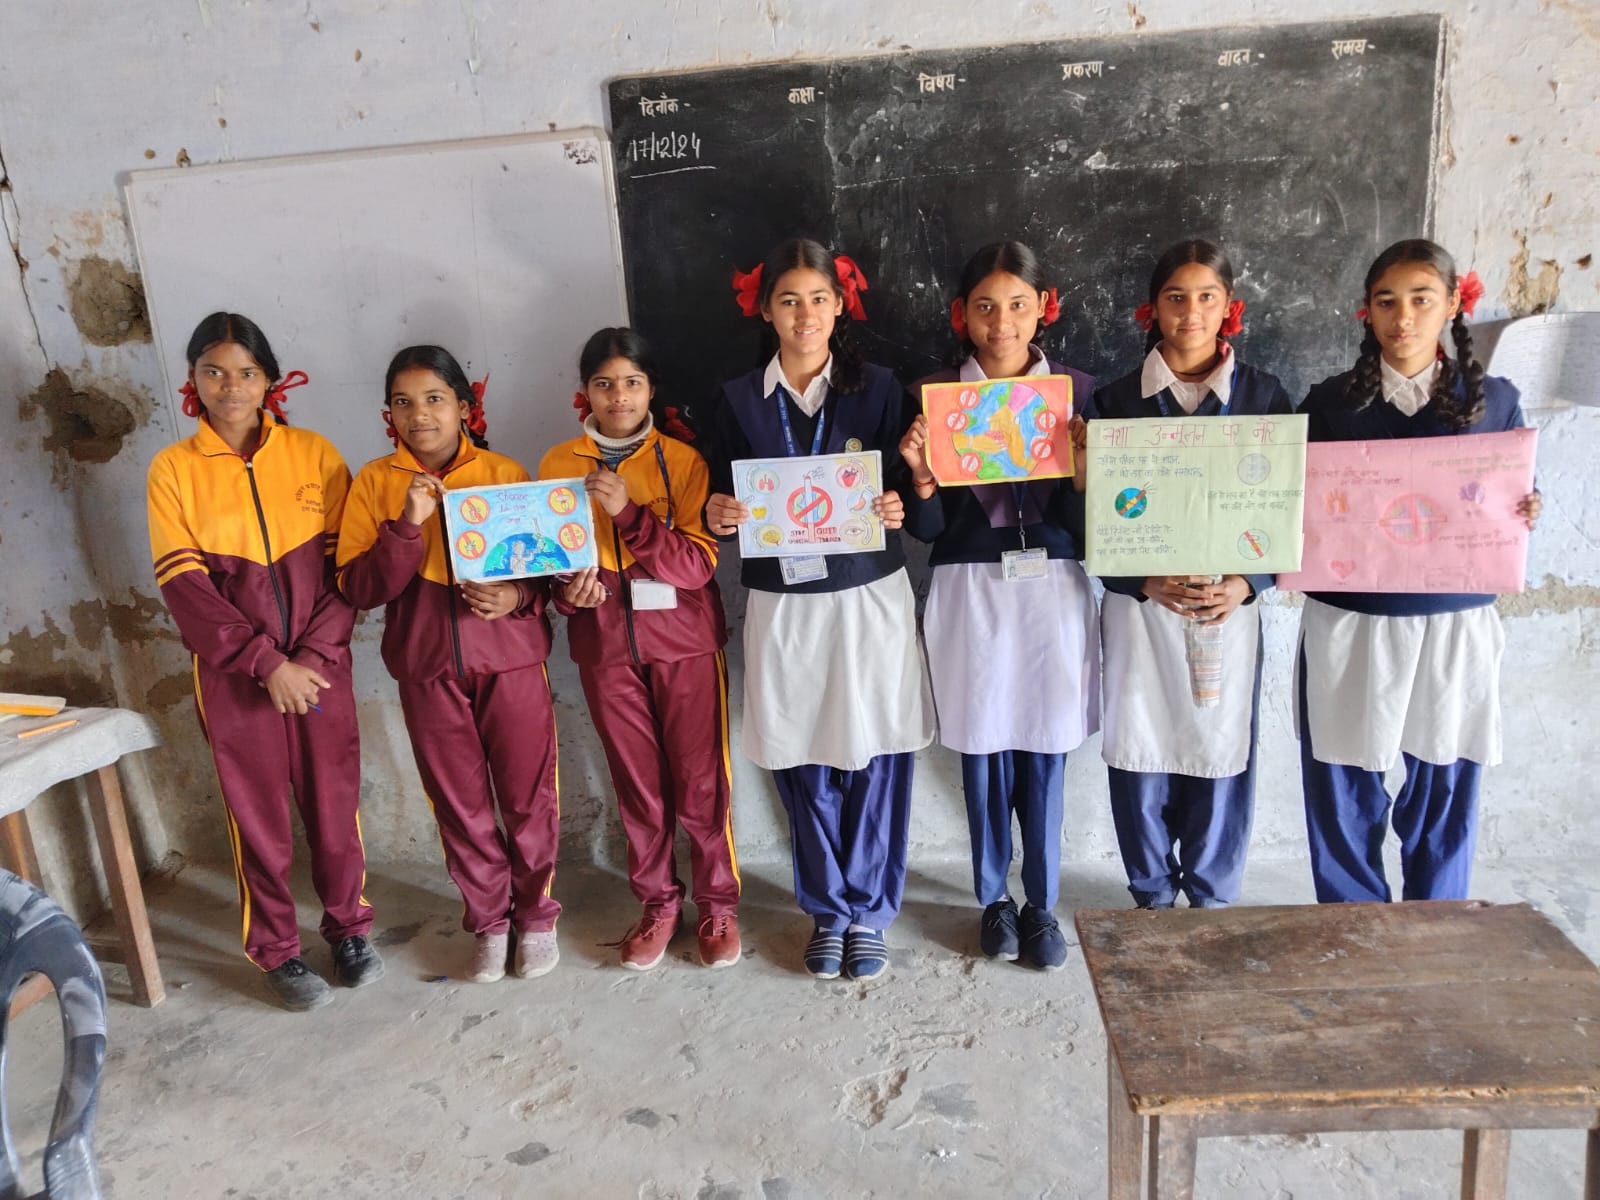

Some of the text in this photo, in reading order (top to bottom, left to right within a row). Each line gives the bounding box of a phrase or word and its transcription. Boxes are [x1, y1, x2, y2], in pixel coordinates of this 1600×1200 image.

[630, 131, 701, 163] 17/12/24
[1103, 425, 1135, 448] नशा
[1219, 423, 1243, 446] पर
